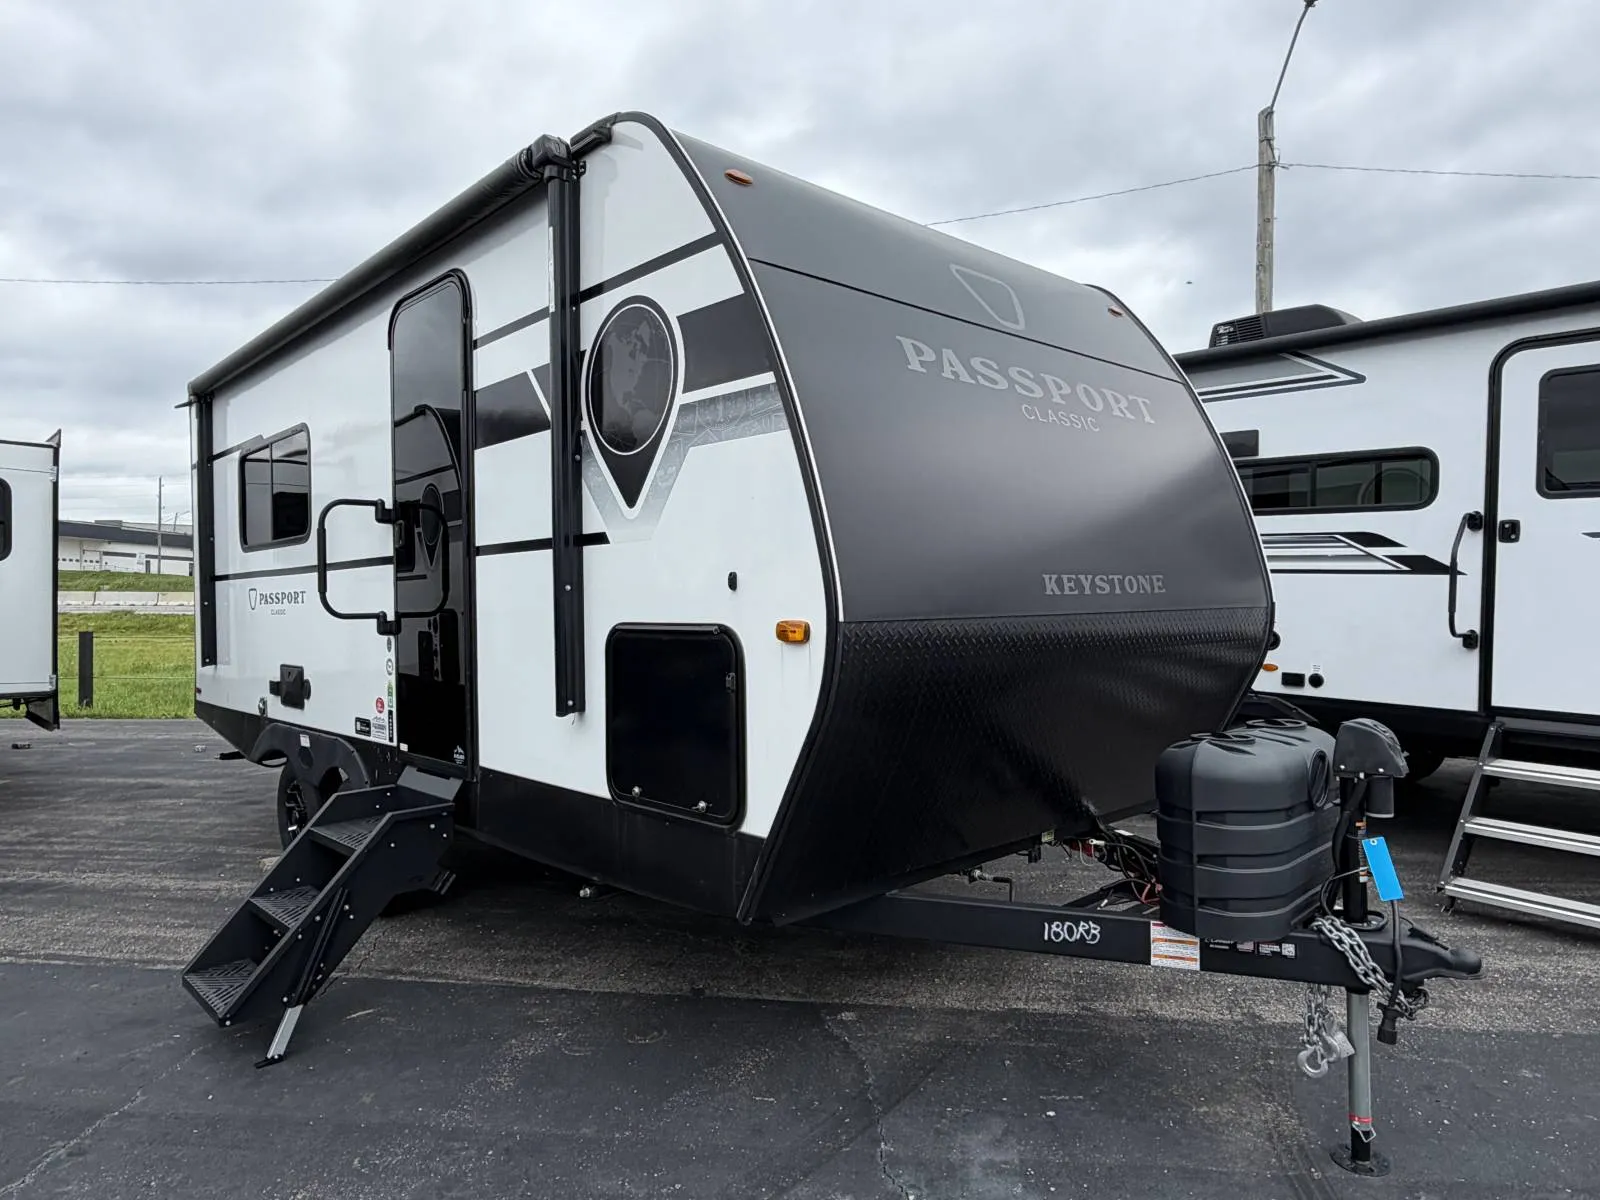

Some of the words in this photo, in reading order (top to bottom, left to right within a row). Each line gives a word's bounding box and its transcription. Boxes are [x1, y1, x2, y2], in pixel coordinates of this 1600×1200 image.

[895, 335, 1155, 424] PASSPORT
[1021, 404, 1100, 432] CLASSIC
[1042, 574, 1166, 595] KEYSTONE
[259, 590, 306, 605] PASSPORT
[1043, 920, 1101, 944] 180RB
